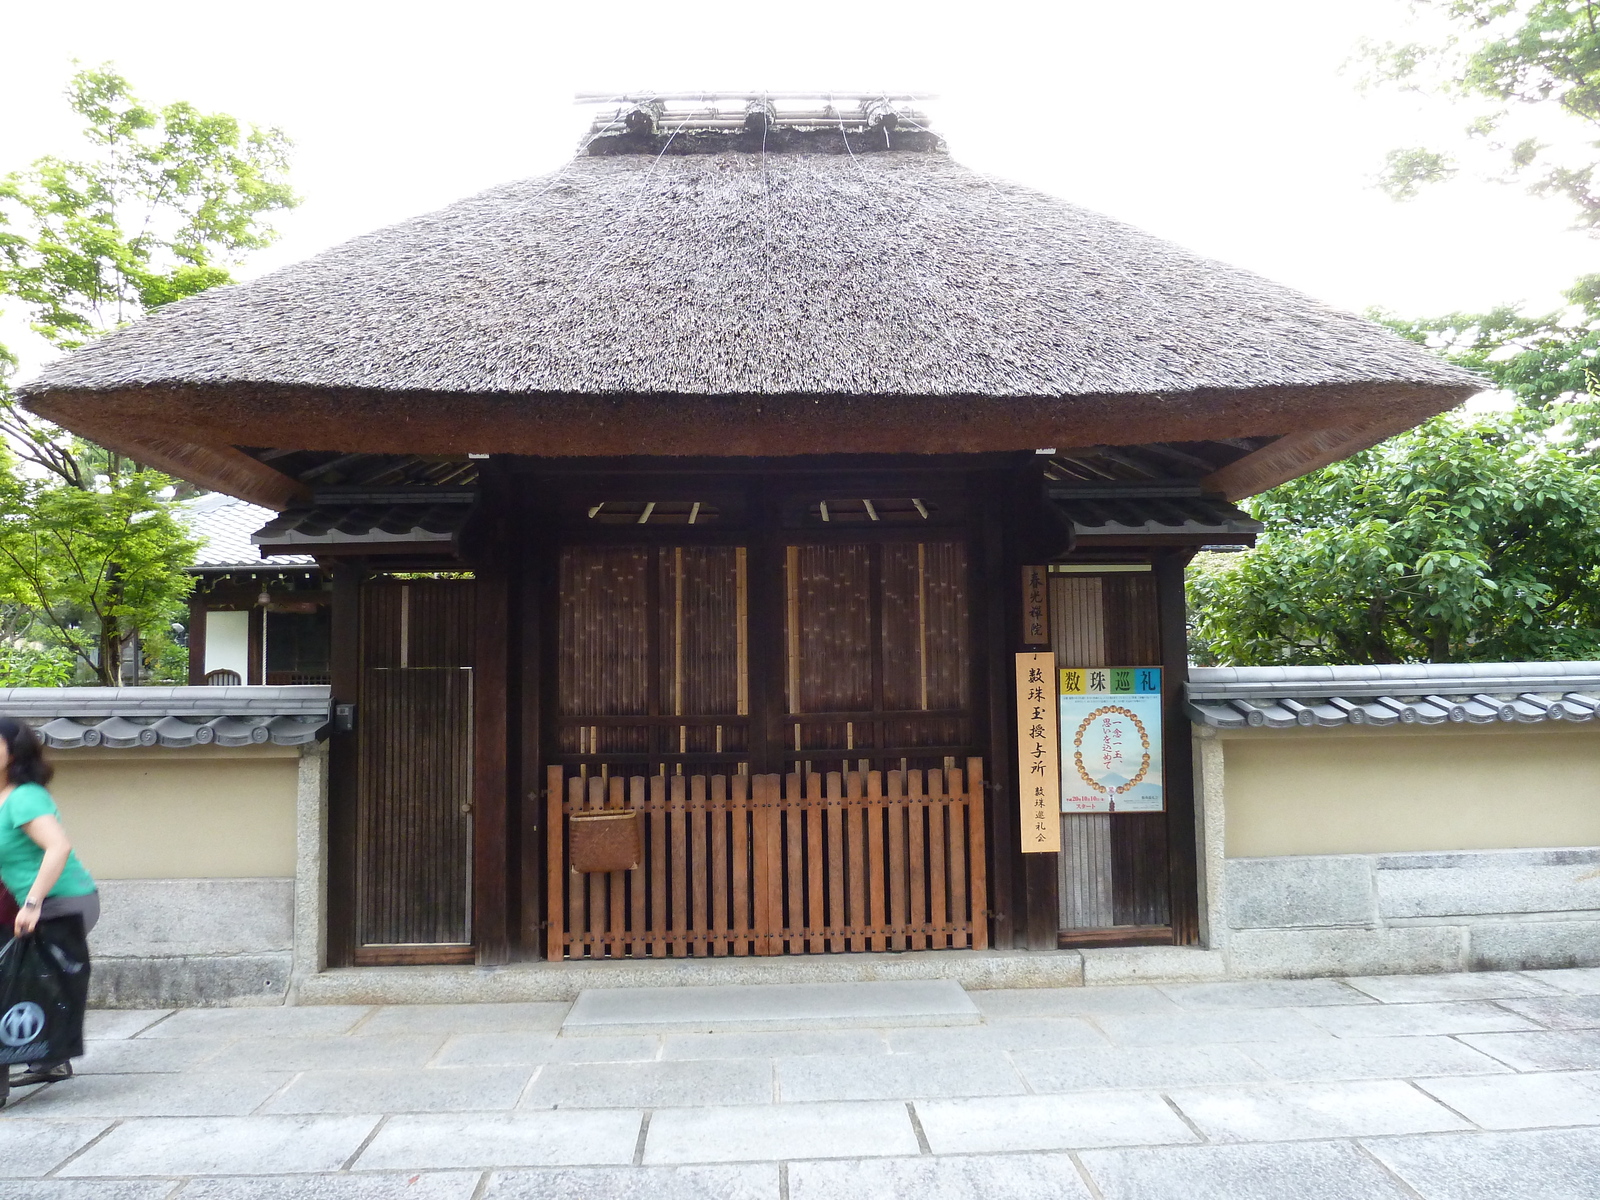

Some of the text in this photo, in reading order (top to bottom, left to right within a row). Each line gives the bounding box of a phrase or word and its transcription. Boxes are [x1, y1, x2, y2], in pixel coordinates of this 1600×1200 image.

[1065, 671, 1156, 692] 数珠巡礼
[1102, 717, 1112, 770] 思いを込めて
